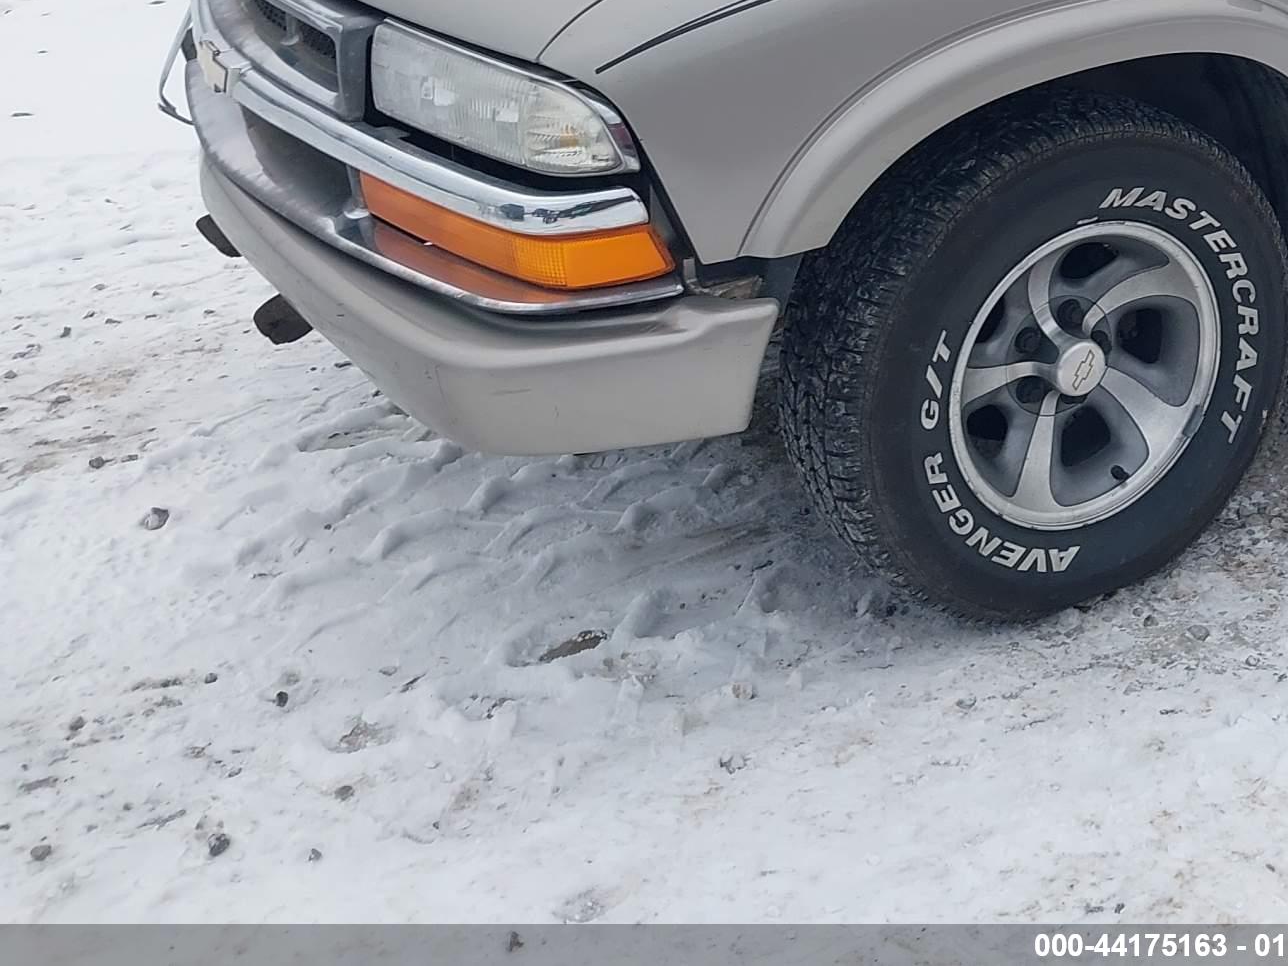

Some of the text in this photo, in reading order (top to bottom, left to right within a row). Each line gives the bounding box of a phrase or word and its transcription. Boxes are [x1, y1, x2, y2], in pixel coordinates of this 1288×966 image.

[1099, 186, 1260, 445] MASTERCRAFT
[920, 329, 1081, 572] AVENGER G/T
